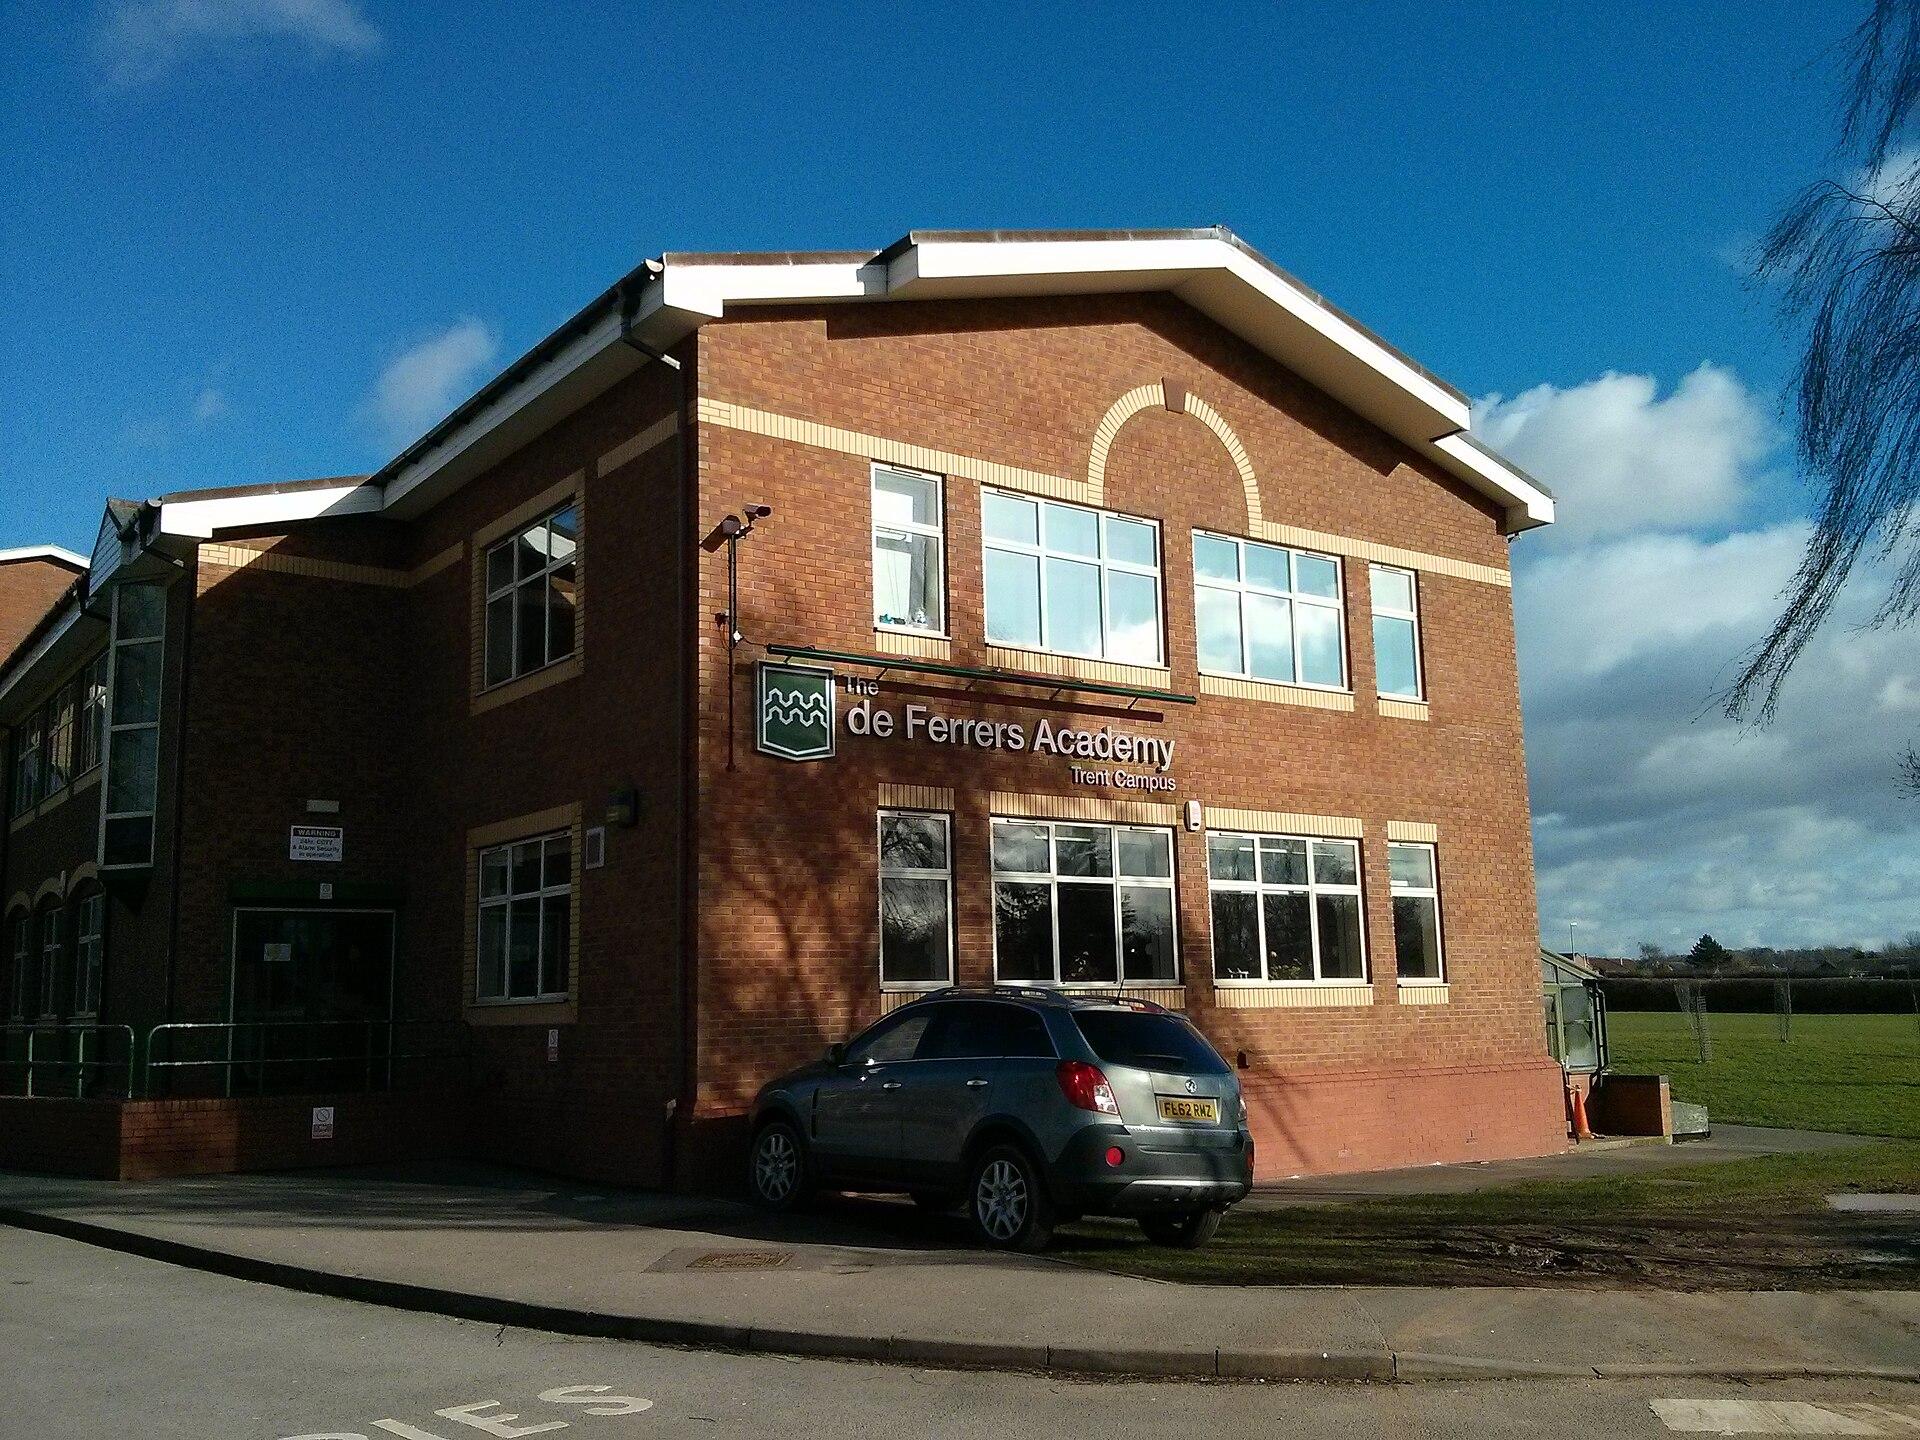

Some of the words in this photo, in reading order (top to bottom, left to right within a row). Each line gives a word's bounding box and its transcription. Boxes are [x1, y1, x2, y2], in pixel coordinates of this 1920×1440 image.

[844, 673, 880, 696] The
[847, 700, 893, 737] de
[906, 704, 1024, 750] Ferrers
[1033, 718, 1176, 770] Academy
[1071, 766, 1111, 787] Trent
[1114, 769, 1177, 792] Campus
[297, 829, 336, 837] WARNING
